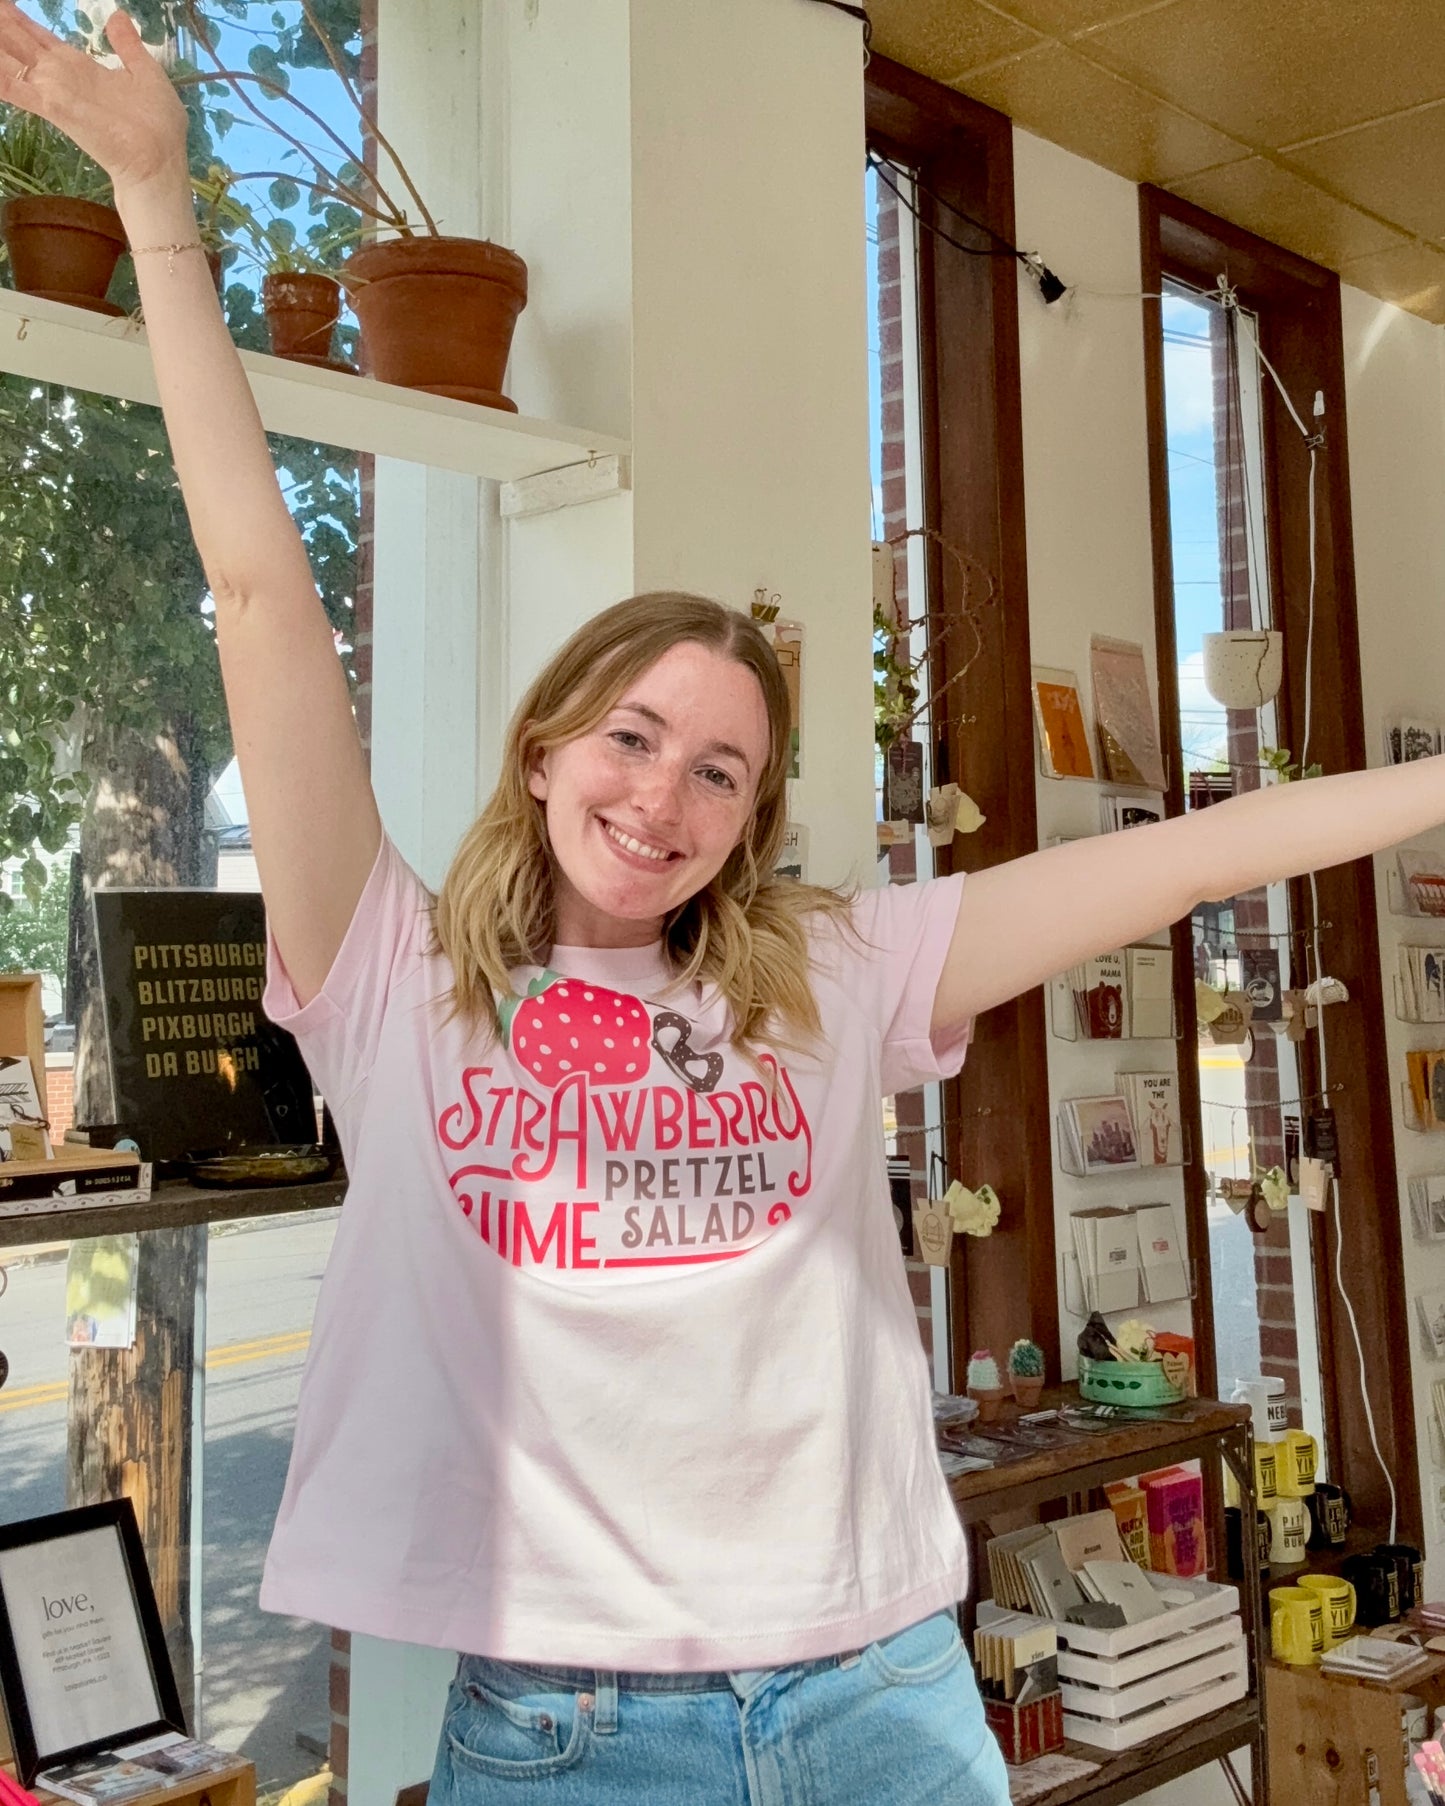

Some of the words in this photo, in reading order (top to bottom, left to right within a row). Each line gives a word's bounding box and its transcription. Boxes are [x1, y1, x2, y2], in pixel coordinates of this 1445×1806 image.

[134, 943, 267, 969] PITTSBURGH
[1100, 969, 1121, 978] MAMA
[142, 1012, 256, 1041] PIXBURGH
[146, 1051, 178, 1078] DA
[1143, 1079, 1157, 1088] YOU
[1159, 1078, 1171, 1087] ARE
[1151, 1090, 1165, 1099] THE
[605, 1151, 776, 1201] PRETZEL
[621, 1201, 755, 1249] SALAD
[42, 1593, 95, 1621] love,
